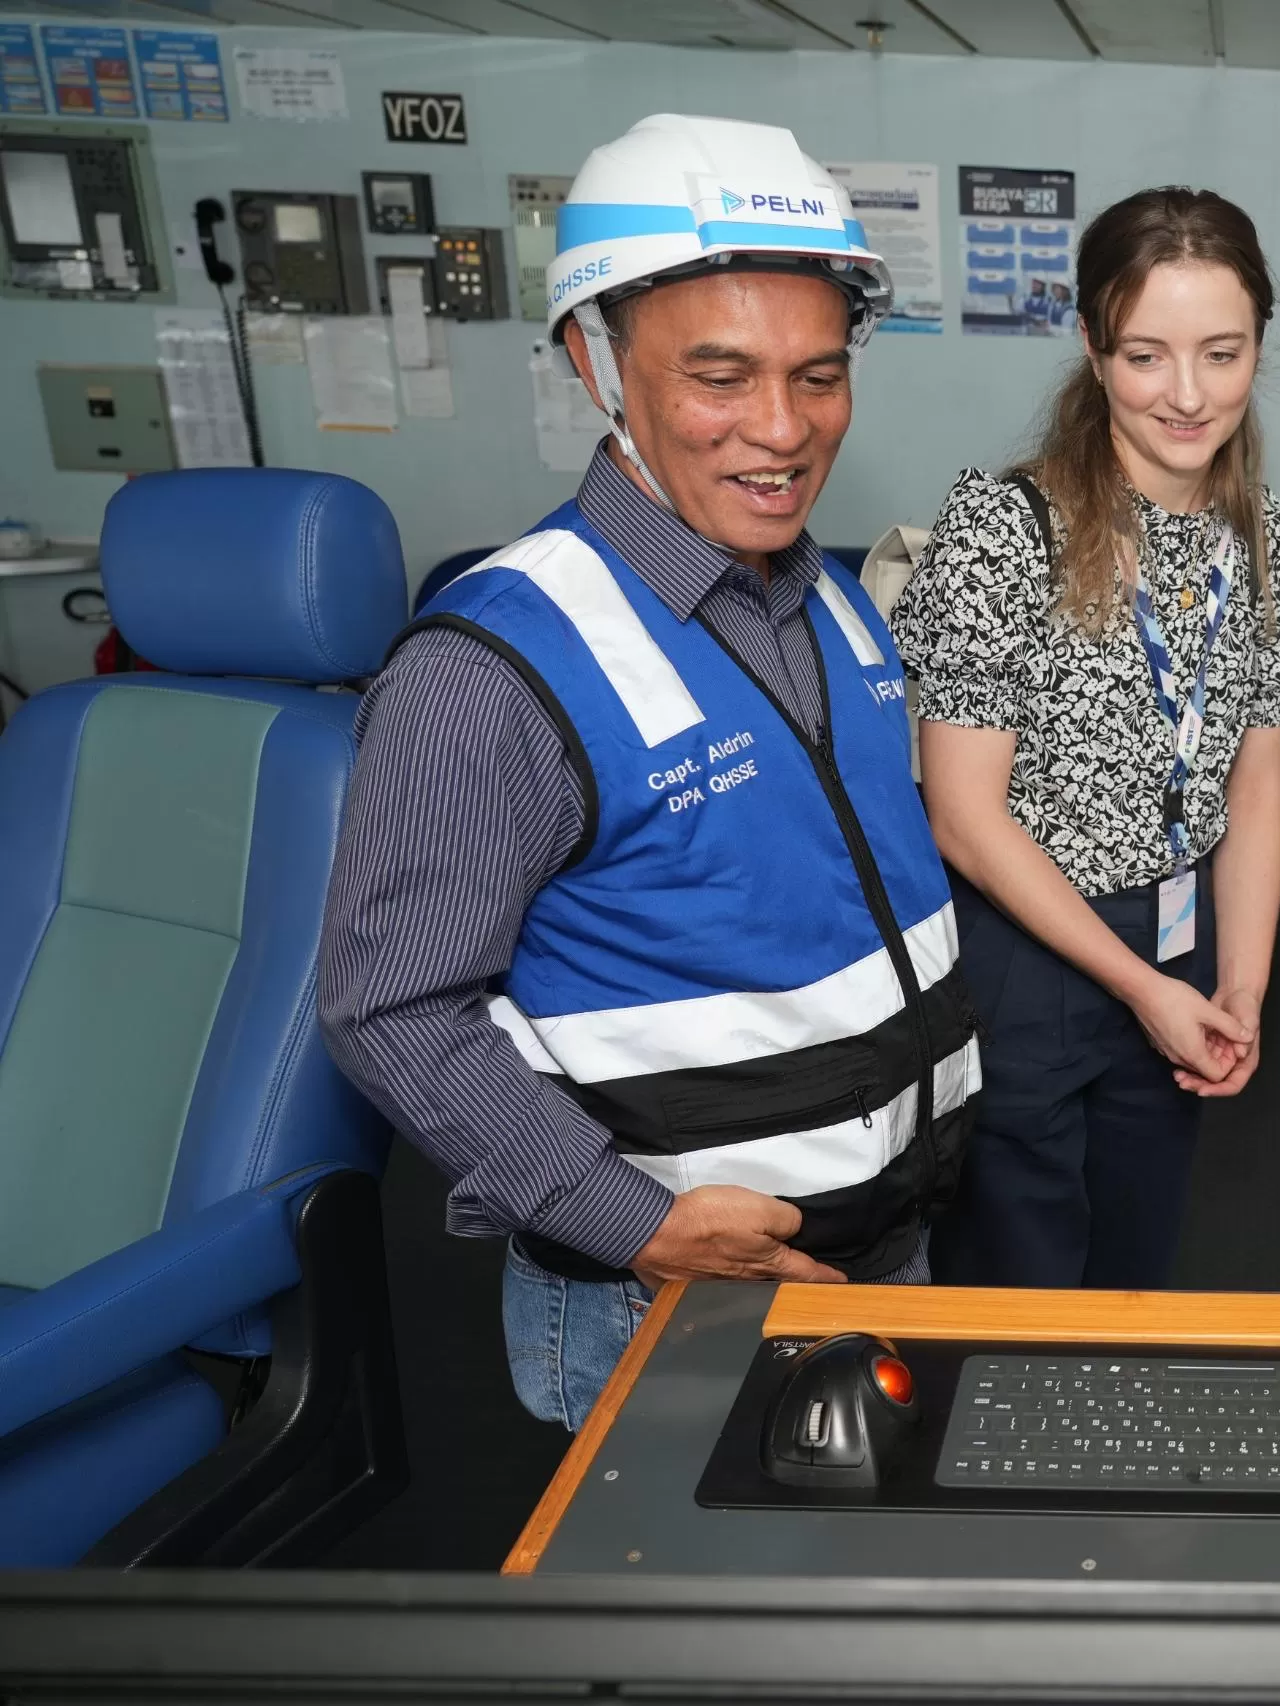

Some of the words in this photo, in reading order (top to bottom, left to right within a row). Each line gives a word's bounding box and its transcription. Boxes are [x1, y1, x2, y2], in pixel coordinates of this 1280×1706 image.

[385, 97, 465, 140] YFOZ
[751, 194, 825, 216] PELNI
[973, 186, 1023, 200] BUDAYA
[553, 256, 612, 303] QHSSE
[648, 757, 702, 790] Capt.
[708, 731, 755, 764] Aldrin
[668, 787, 706, 813] DPA
[709, 759, 758, 793] QHSSE
